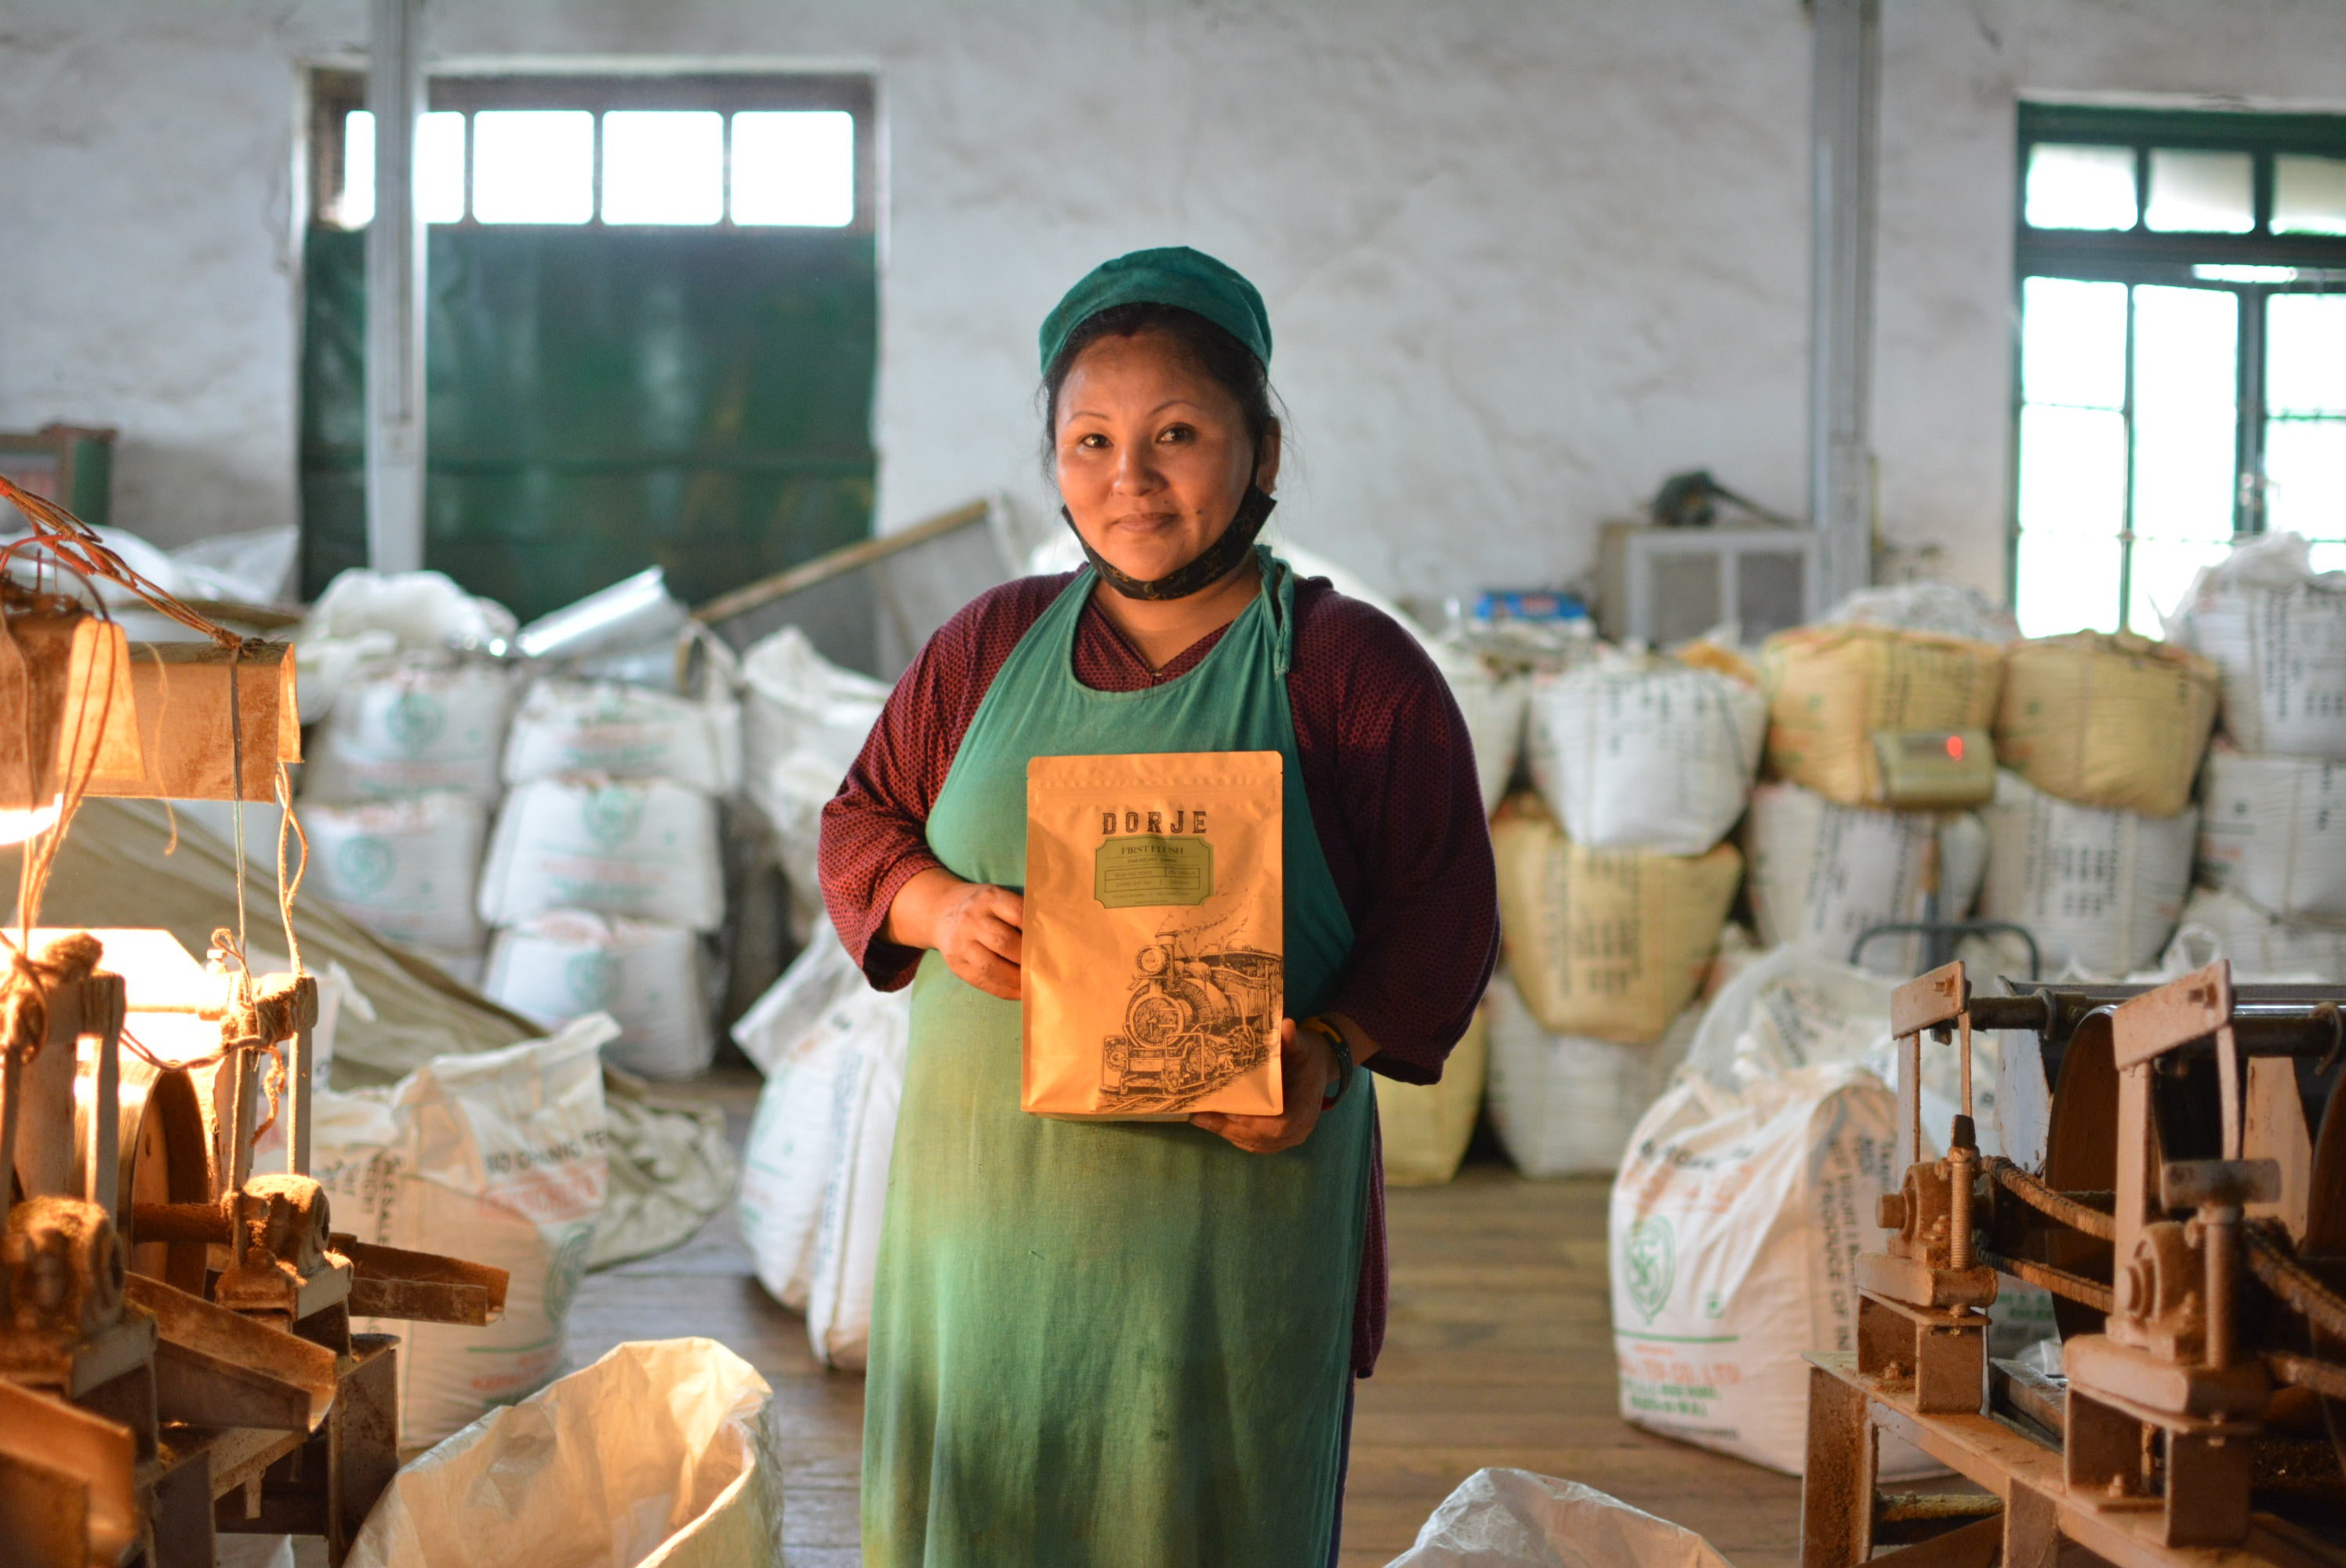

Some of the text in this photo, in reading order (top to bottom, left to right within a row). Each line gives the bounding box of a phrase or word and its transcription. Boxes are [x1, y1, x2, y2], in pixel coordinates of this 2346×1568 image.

[1102, 811, 1207, 834] DORJE
[1121, 845, 1183, 855] FIRST FLUSH
[1820, 1179, 1847, 1283] PRODUCE
[1830, 1290, 1849, 1319] OF
